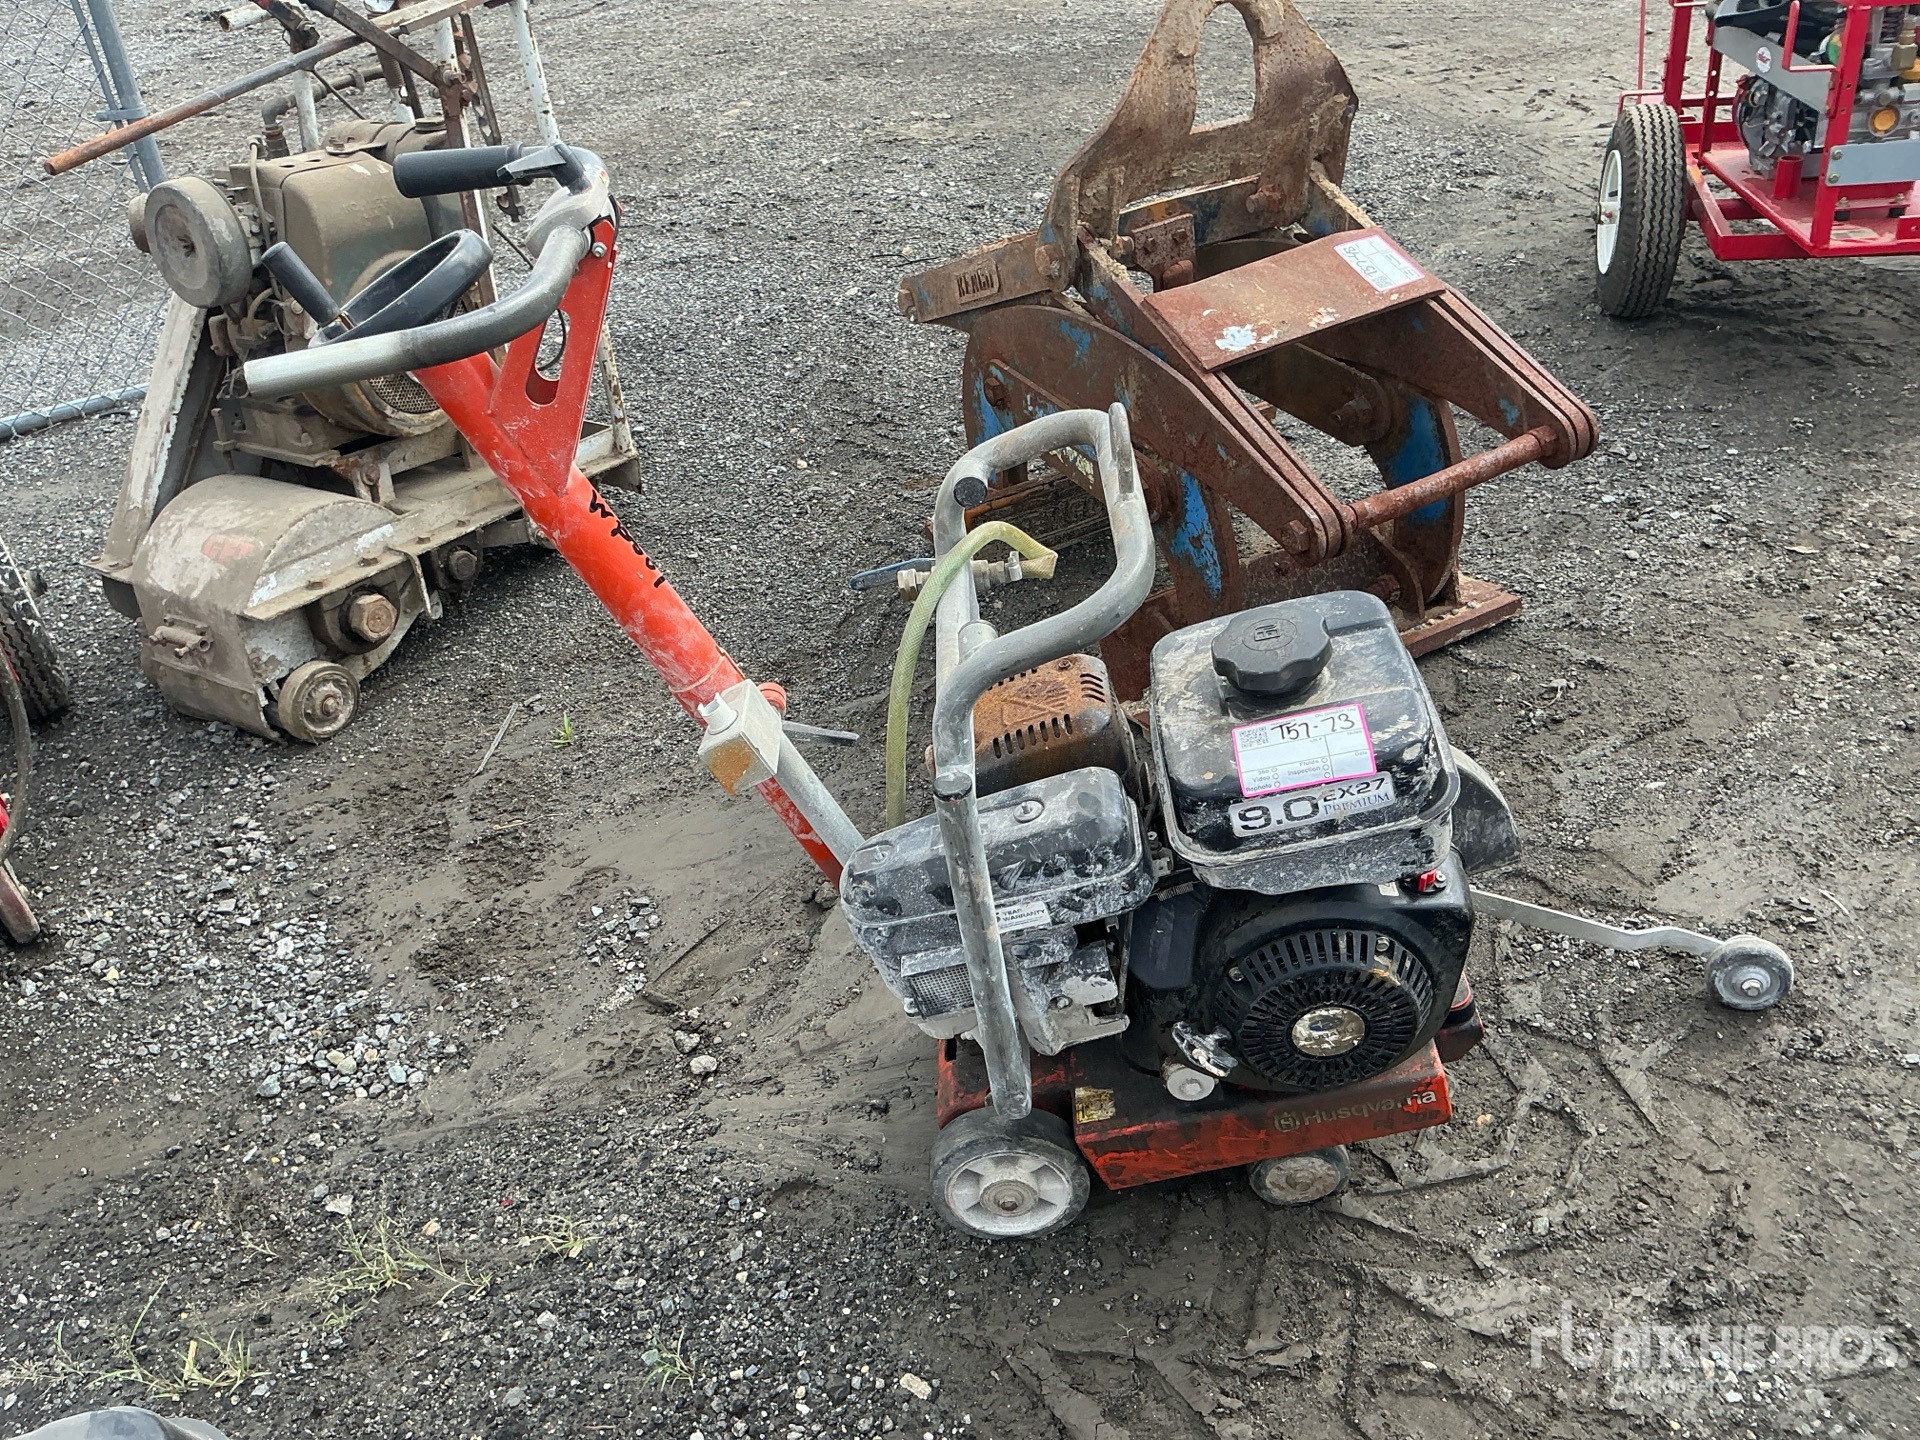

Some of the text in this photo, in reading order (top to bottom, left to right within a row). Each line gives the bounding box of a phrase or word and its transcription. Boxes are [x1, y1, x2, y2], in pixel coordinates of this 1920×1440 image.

[1270, 713, 1356, 741] T57-73
[1252, 775, 1271, 783] Video
[1287, 766, 1321, 776] Inspection
[1245, 783, 1272, 793] Rephoto
[1322, 777, 1386, 803] EX27
[1237, 795, 1320, 831] 9.0
[1323, 792, 1391, 815] PREMIUM
[1002, 909, 1045, 922] WARRANTY
[1302, 1090, 1437, 1126] Husqvarna
